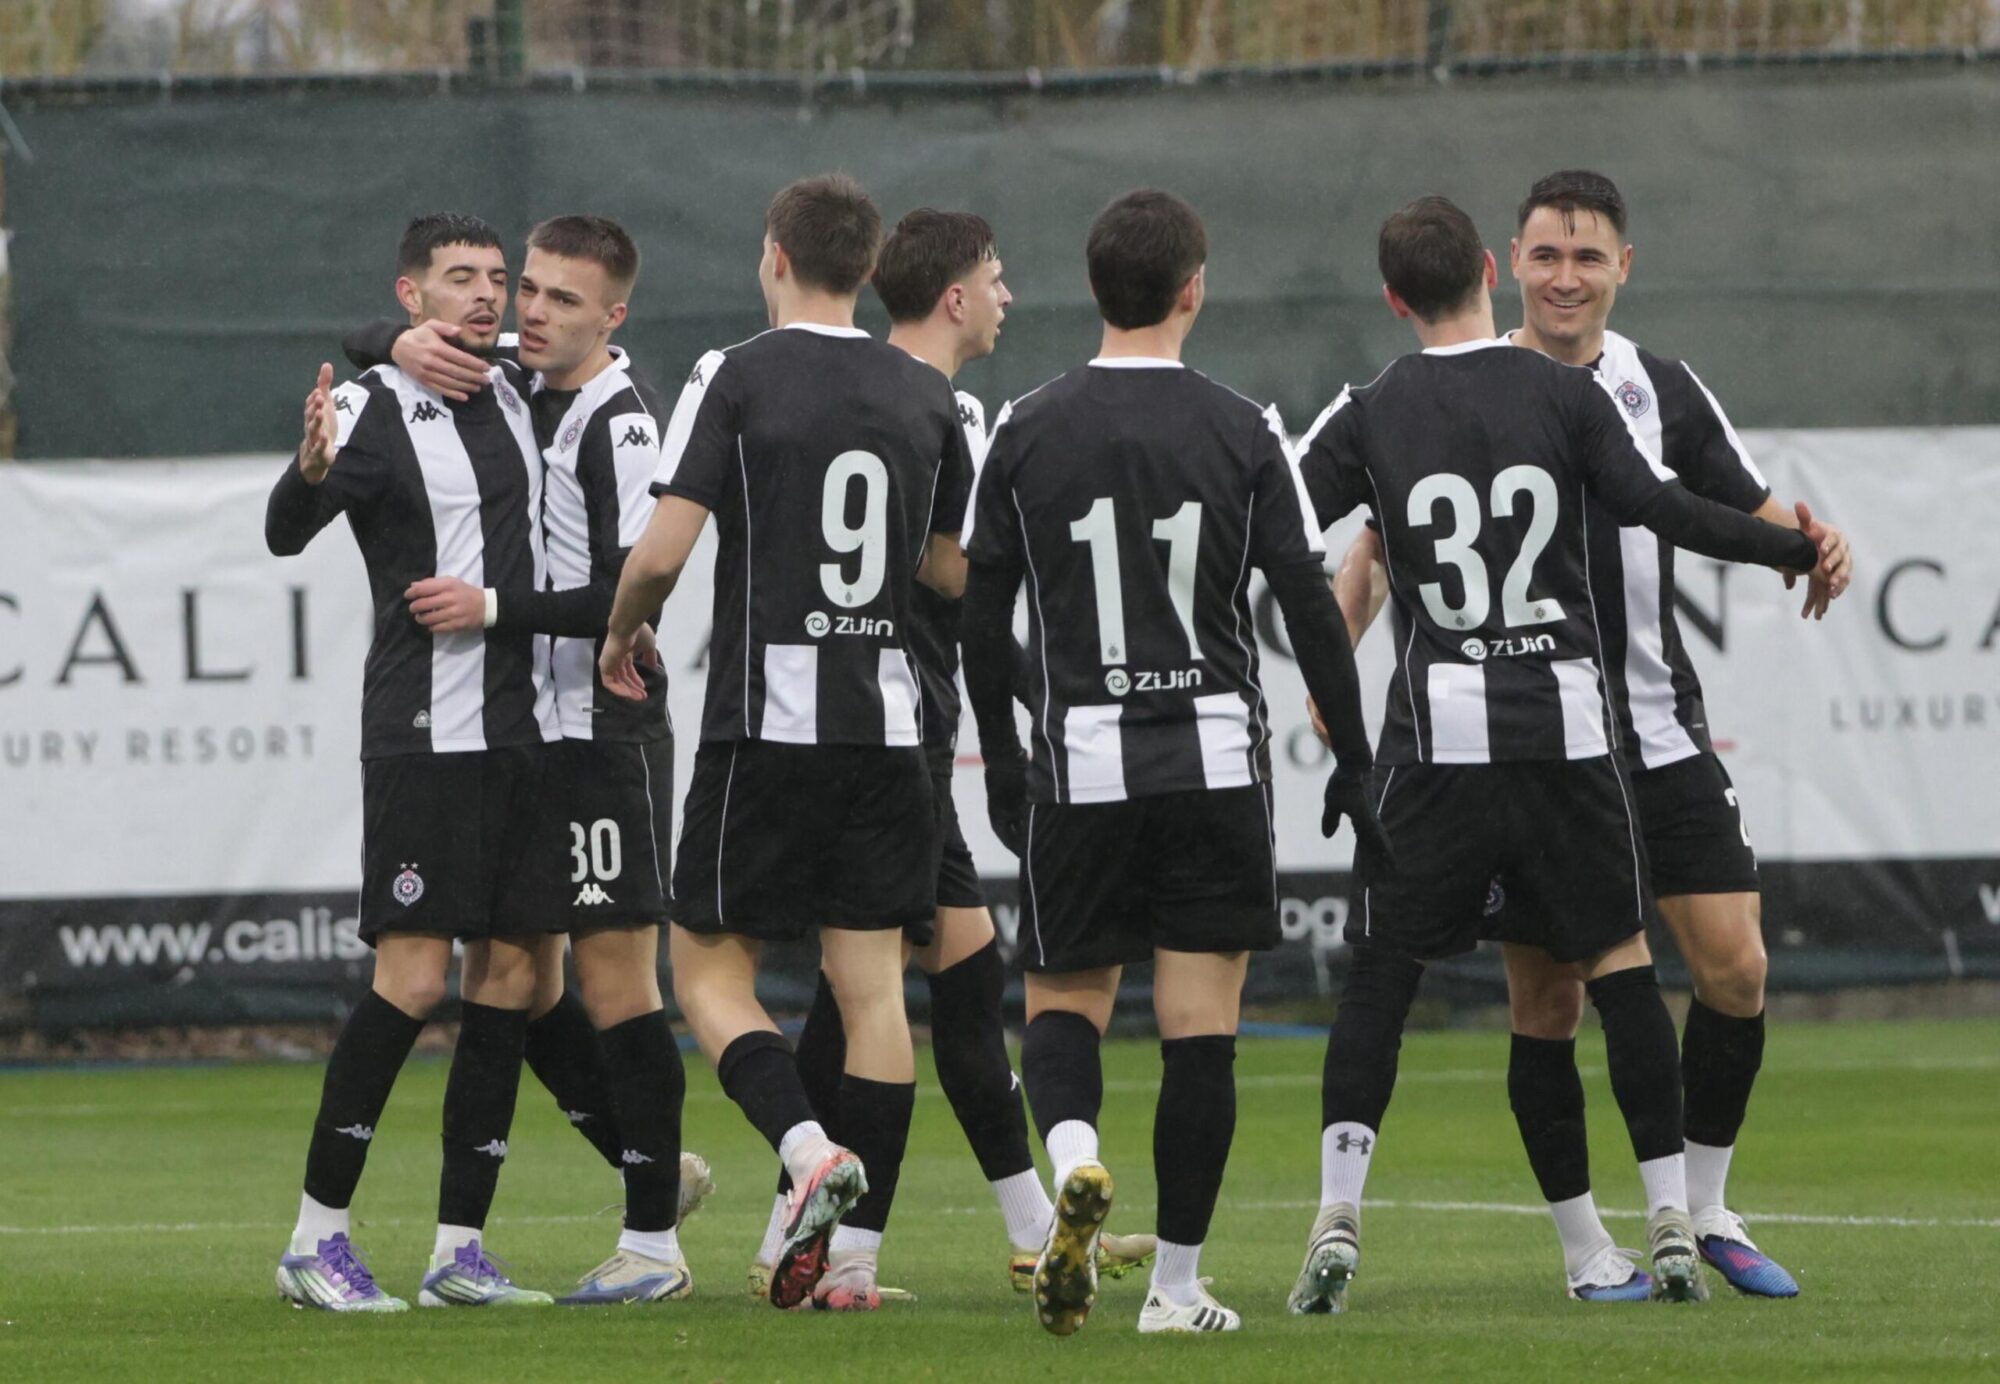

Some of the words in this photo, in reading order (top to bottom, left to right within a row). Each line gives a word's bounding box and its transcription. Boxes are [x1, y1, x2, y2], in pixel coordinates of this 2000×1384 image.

[819, 449, 889, 608] 9
[1069, 497, 1205, 665] 11
[1407, 464, 1568, 631] 32
[125, 723, 317, 766] RESORT
[1831, 694, 2000, 731] LUXUR
[569, 818, 622, 883] 30
